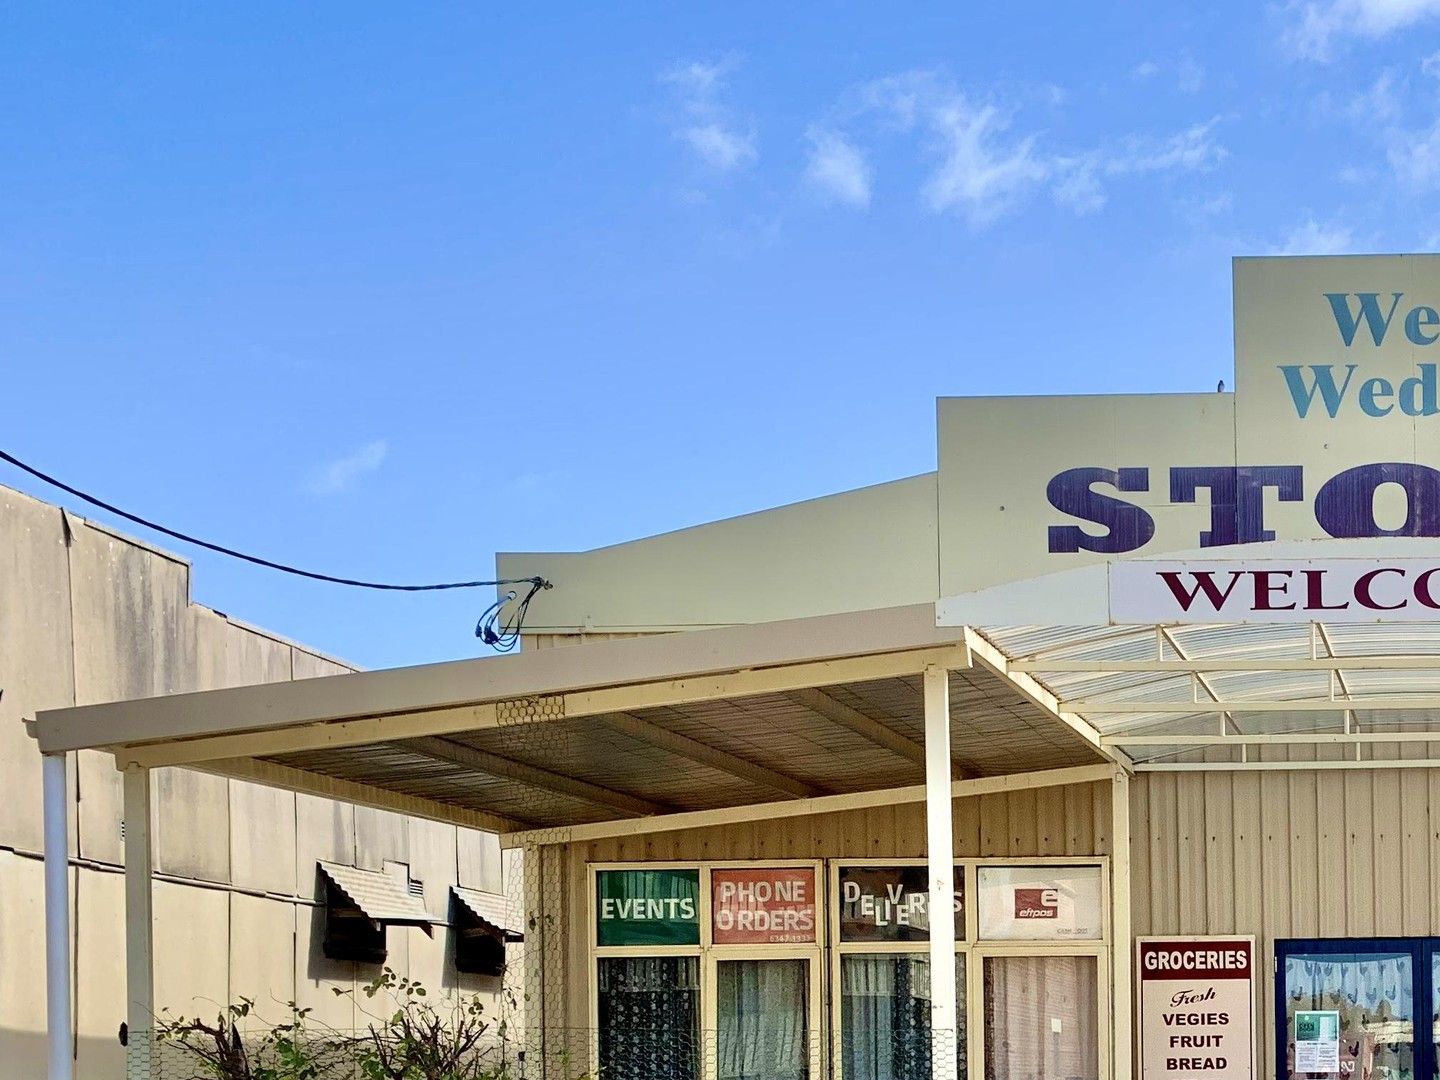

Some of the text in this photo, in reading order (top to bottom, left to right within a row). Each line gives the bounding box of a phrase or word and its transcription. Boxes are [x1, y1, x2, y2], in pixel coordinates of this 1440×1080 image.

[721, 881, 805, 903] PHONE
[601, 898, 695, 920] EVENTS
[1019, 909, 1054, 918] eftpos
[717, 909, 814, 931] ORDERS
[1144, 950, 1247, 970] GROCERIES
[1170, 987, 1217, 1008] Fresh
[1162, 1013, 1229, 1026] VEGIES
[1169, 1035, 1223, 1048] FRUIT
[1166, 1057, 1227, 1070] BREAD
